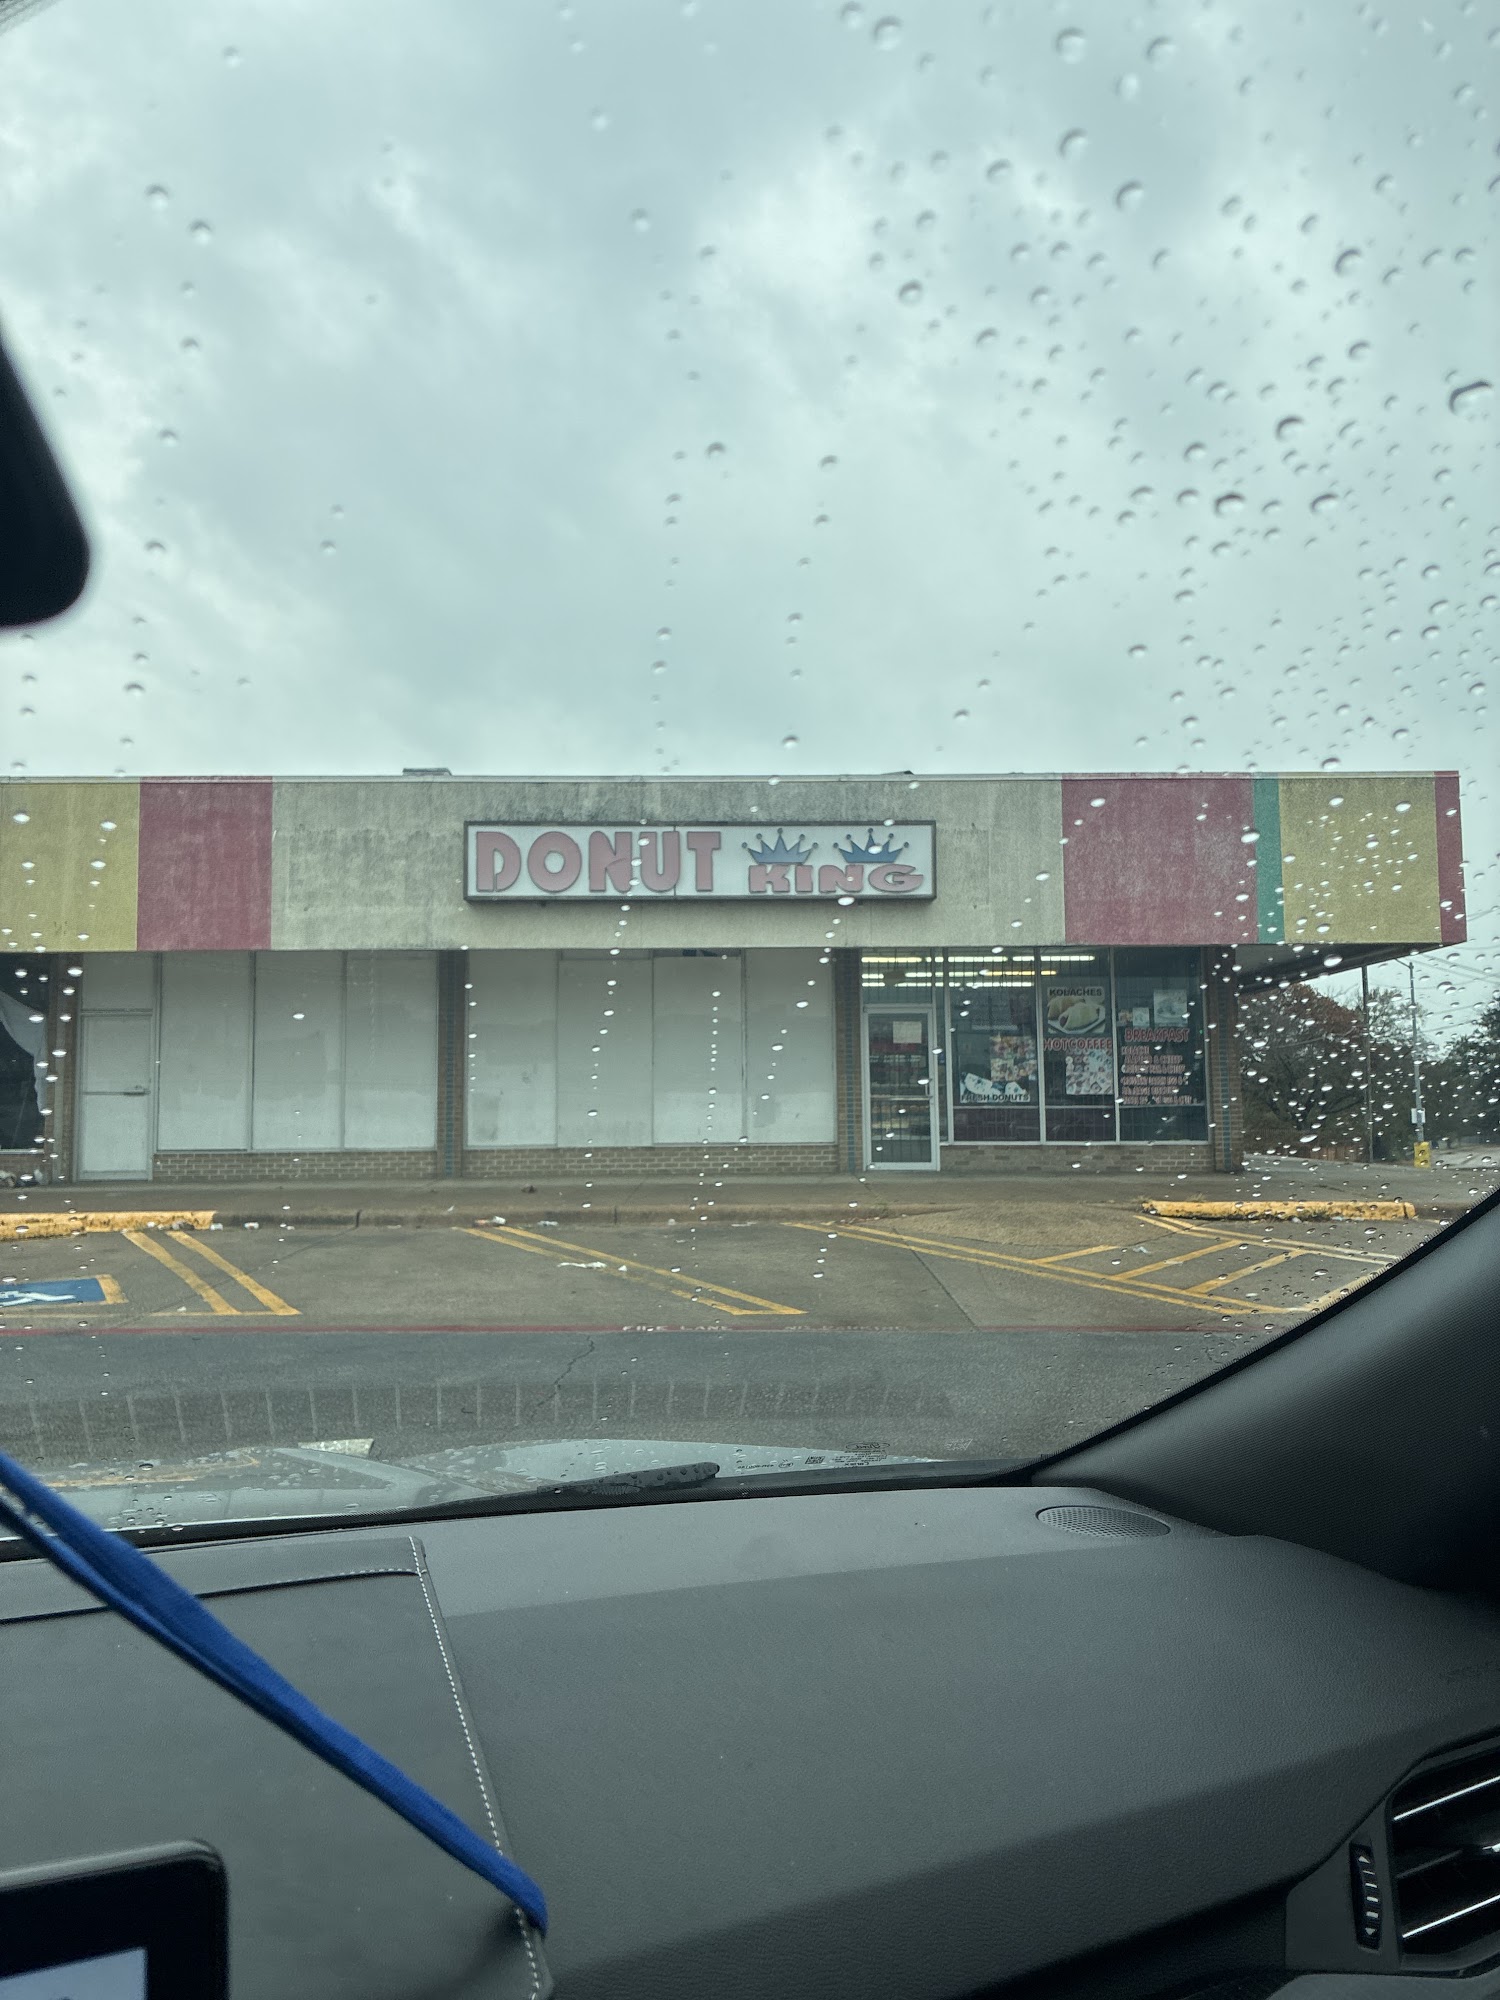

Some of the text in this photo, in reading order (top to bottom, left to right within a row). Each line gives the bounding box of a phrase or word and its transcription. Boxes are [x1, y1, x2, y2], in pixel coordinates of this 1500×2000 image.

[476, 830, 924, 894] DONUT KING
[1125, 1028, 1190, 1042] BREAKFAST
[992, 1093, 1029, 1102] DONUTS
